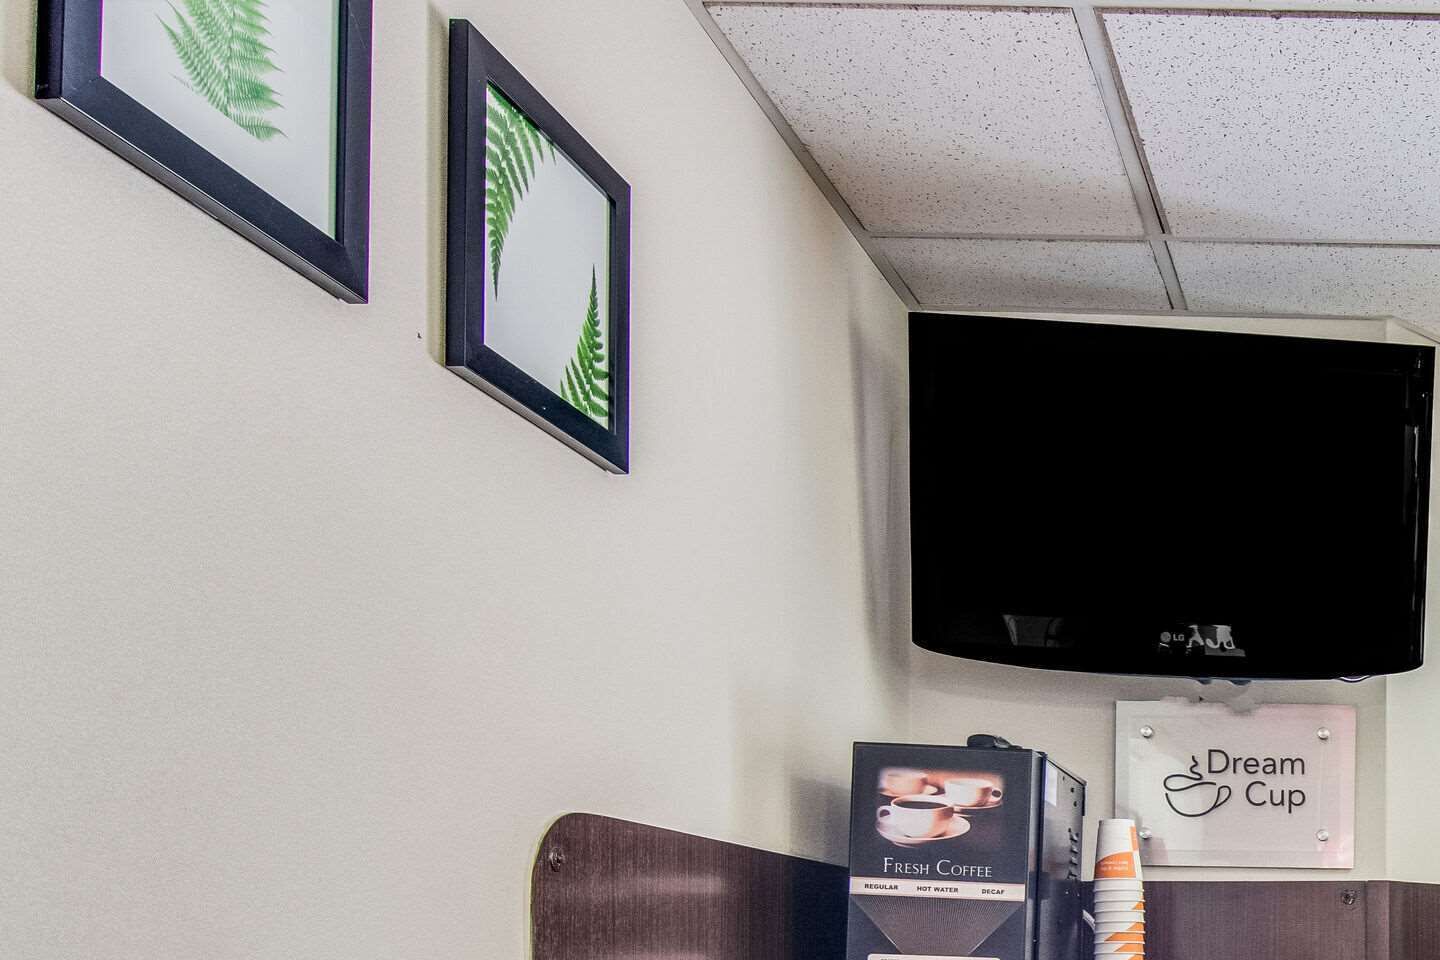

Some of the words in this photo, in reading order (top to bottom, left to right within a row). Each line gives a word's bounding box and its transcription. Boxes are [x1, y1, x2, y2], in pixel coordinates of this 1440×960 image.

[1172, 633, 1185, 641] LG
[1207, 749, 1305, 775] Dream
[1245, 781, 1306, 814] Cup
[883, 857, 929, 875] FRESH
[936, 859, 992, 878] COFFEE
[864, 883, 899, 891] REGULAR
